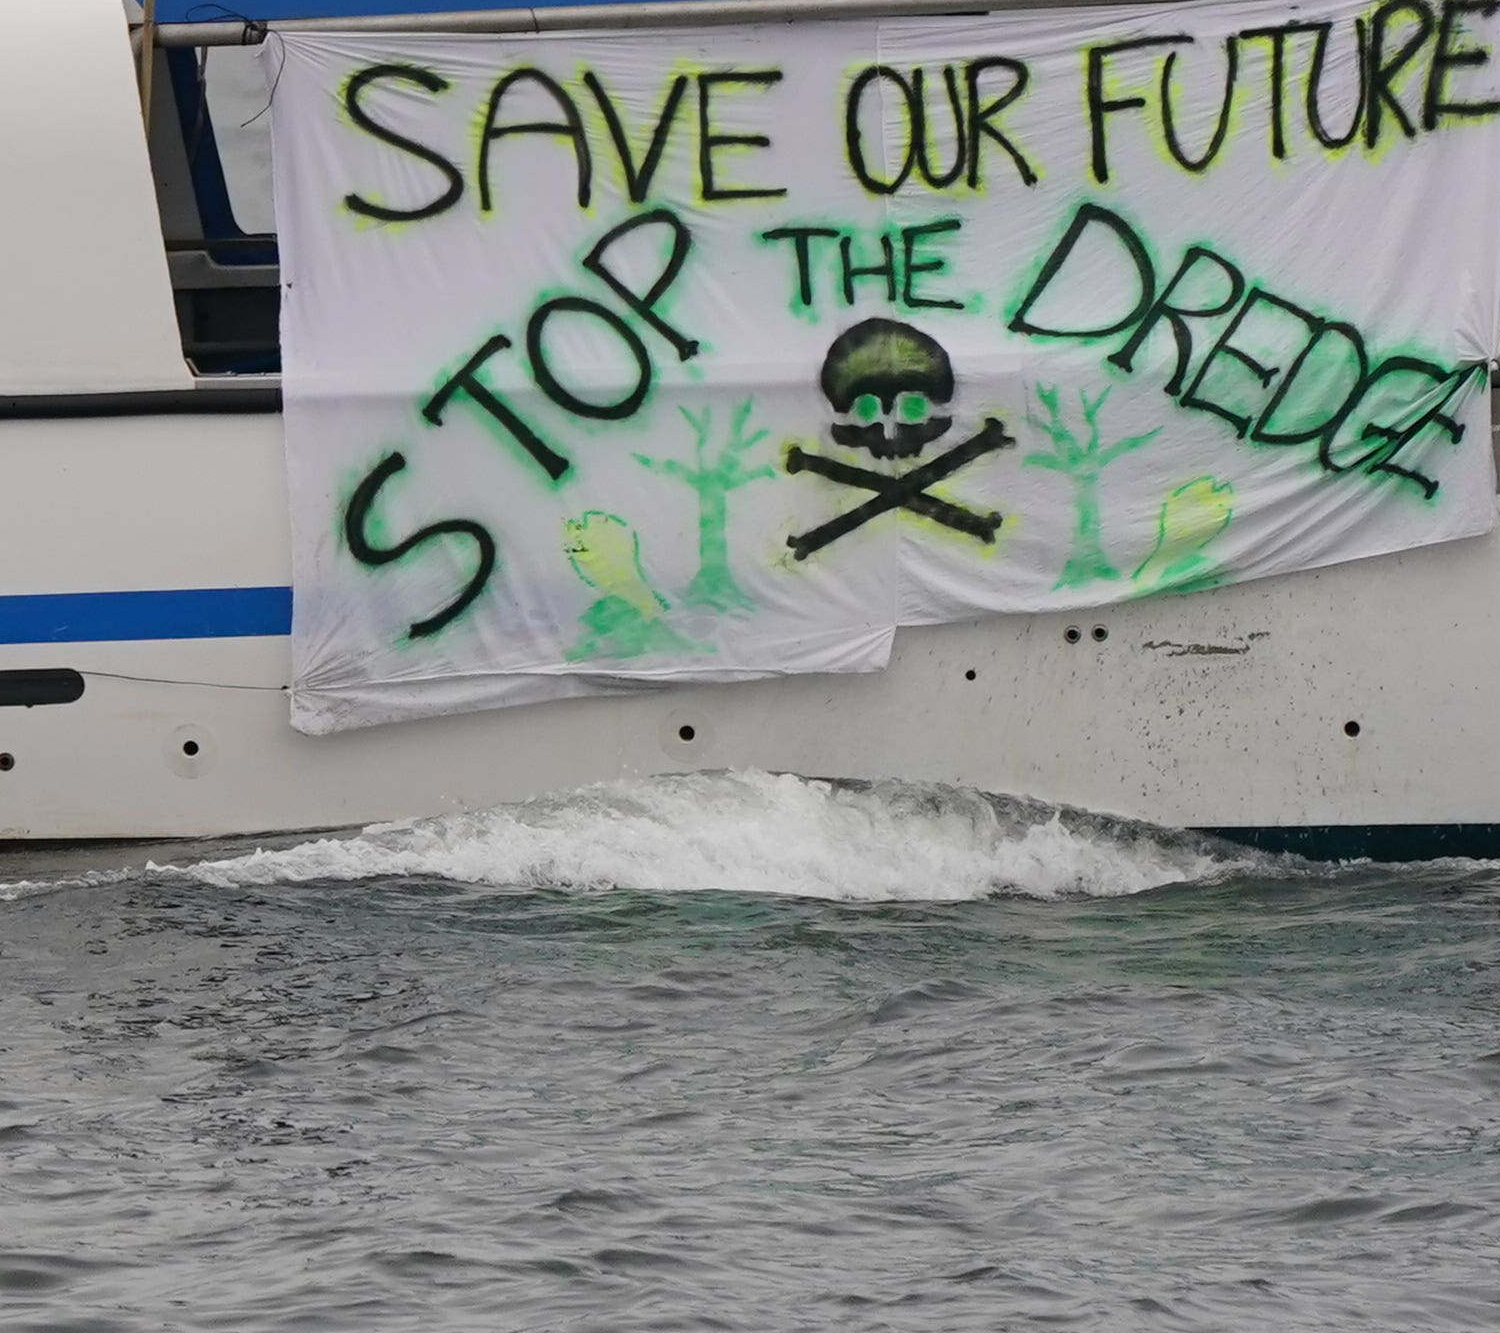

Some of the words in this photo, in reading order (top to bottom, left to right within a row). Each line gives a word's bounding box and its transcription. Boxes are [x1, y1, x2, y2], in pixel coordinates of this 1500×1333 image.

[342, 61, 787, 223] SAVE
[845, 57, 1039, 195] OUR
[342, 207, 700, 639] STOP
[763, 218, 966, 311] THE
[1007, 201, 1488, 501] DREDGE
